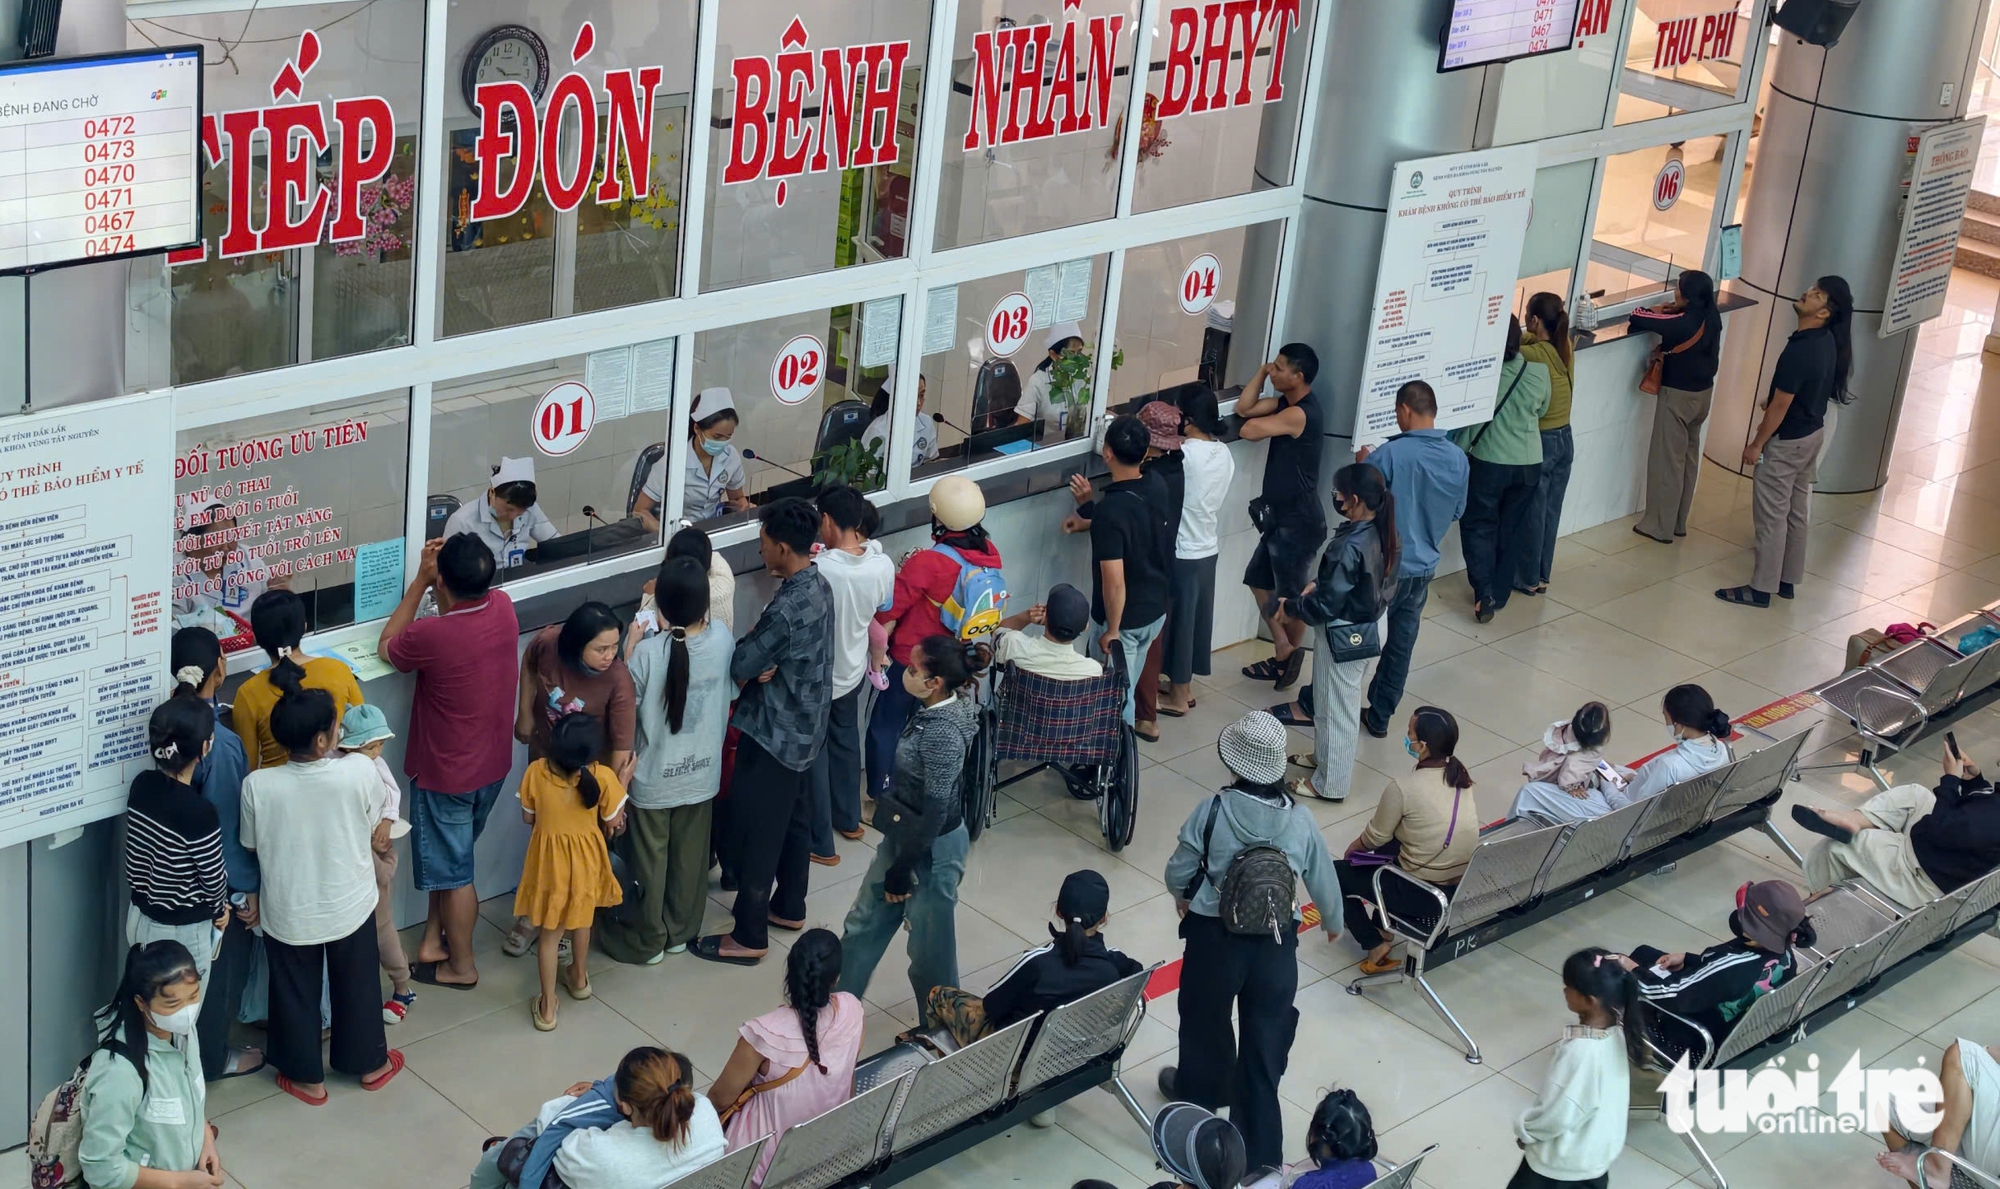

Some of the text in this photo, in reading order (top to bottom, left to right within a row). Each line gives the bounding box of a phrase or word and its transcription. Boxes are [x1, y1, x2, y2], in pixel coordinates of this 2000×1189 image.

[1534, 9, 1553, 22] 0471
[1531, 23, 1551, 38] 0467
[1652, 17, 1698, 71] THU
[1697, 1, 1740, 62] PHÍ
[493, 46, 499, 56] 11
[504, 43, 512, 53] 12
[1528, 40, 1548, 53] 0474
[484, 57, 492, 66] 10
[34, 100, 68, 112] ĐANG
[72, 94, 99, 108] CHỜ
[470, 21, 663, 222] ĐÓN
[723, 14, 911, 208] BỆNH
[963, 0, 1124, 152] NHÂN
[1155, 0, 1300, 120] BHYT
[84, 116, 135, 138] 0472
[84, 140, 135, 162] 0473
[85, 164, 135, 186] 0470
[1658, 171, 1679, 202] 06
[85, 188, 132, 210] 0471
[1449, 186, 1482, 198] QUY TRÌNH
[85, 211, 135, 234] 0467
[85, 234, 135, 257] 0474
[1185, 266, 1215, 302] 04
[992, 306, 1028, 343] 03
[779, 351, 818, 390] 02
[541, 396, 586, 440] 01
[174, 418, 368, 479] ĐỐI TƯỢNG ƯU TIÊN
[12, 459, 144, 499] THẺ BẢO HIỂM Y TẾ
[18, 461, 62, 479] TRÌNH
[214, 481, 232, 499] CÓ
[238, 476, 271, 494] THAI
[190, 512, 212, 526] EM
[216, 500, 249, 521] DƯỚI
[253, 500, 262, 513] 6
[268, 486, 299, 510] TUỔI
[173, 533, 201, 554] ƯỜI
[266, 515, 290, 533] TẬT
[172, 558, 201, 578] ƯỜI
[228, 551, 244, 564] 80
[250, 535, 281, 559] TUỔI
[286, 529, 312, 553] TRỞ
[315, 528, 342, 547] LÊN
[172, 581, 200, 600] ƯỜI
[204, 576, 222, 594] CÓ
[268, 560, 293, 579] VỚI
[296, 551, 333, 574] CÁCH
[1455, 934, 1477, 958] PK
